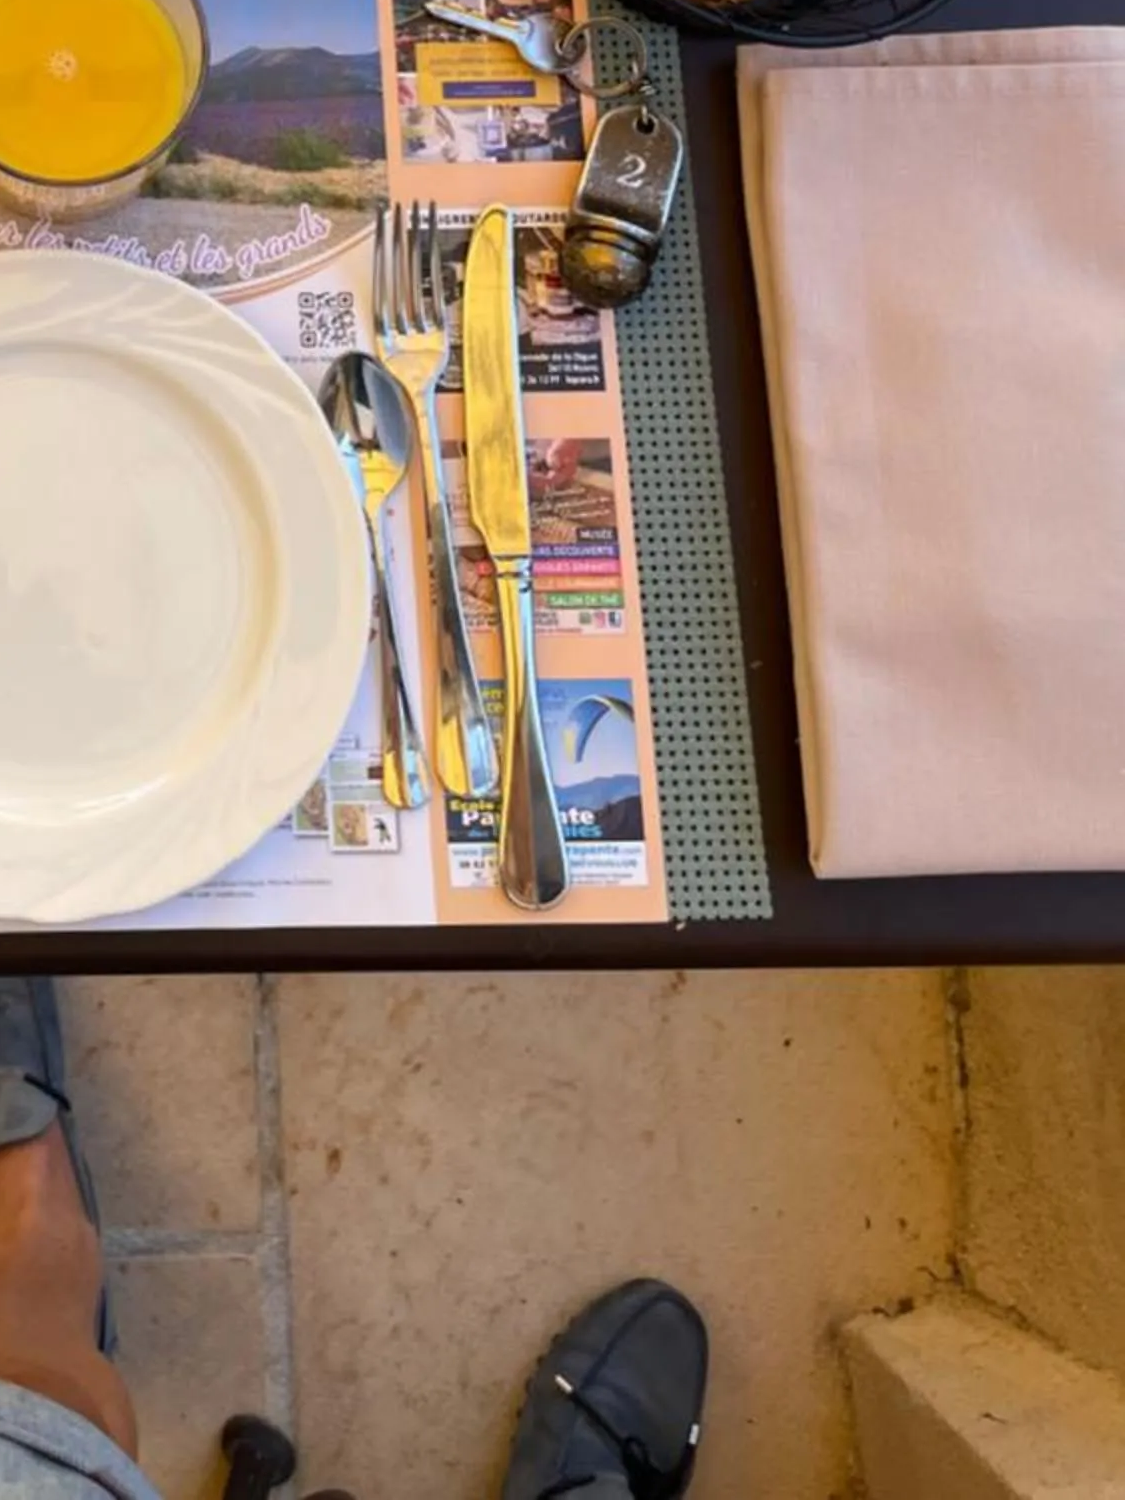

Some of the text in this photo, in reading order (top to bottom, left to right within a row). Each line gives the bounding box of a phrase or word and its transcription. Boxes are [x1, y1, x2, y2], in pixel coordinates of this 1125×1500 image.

[616, 153, 648, 188] 2
[155, 239, 188, 275] et
[190, 231, 233, 275] les
[235, 202, 332, 279] grands
